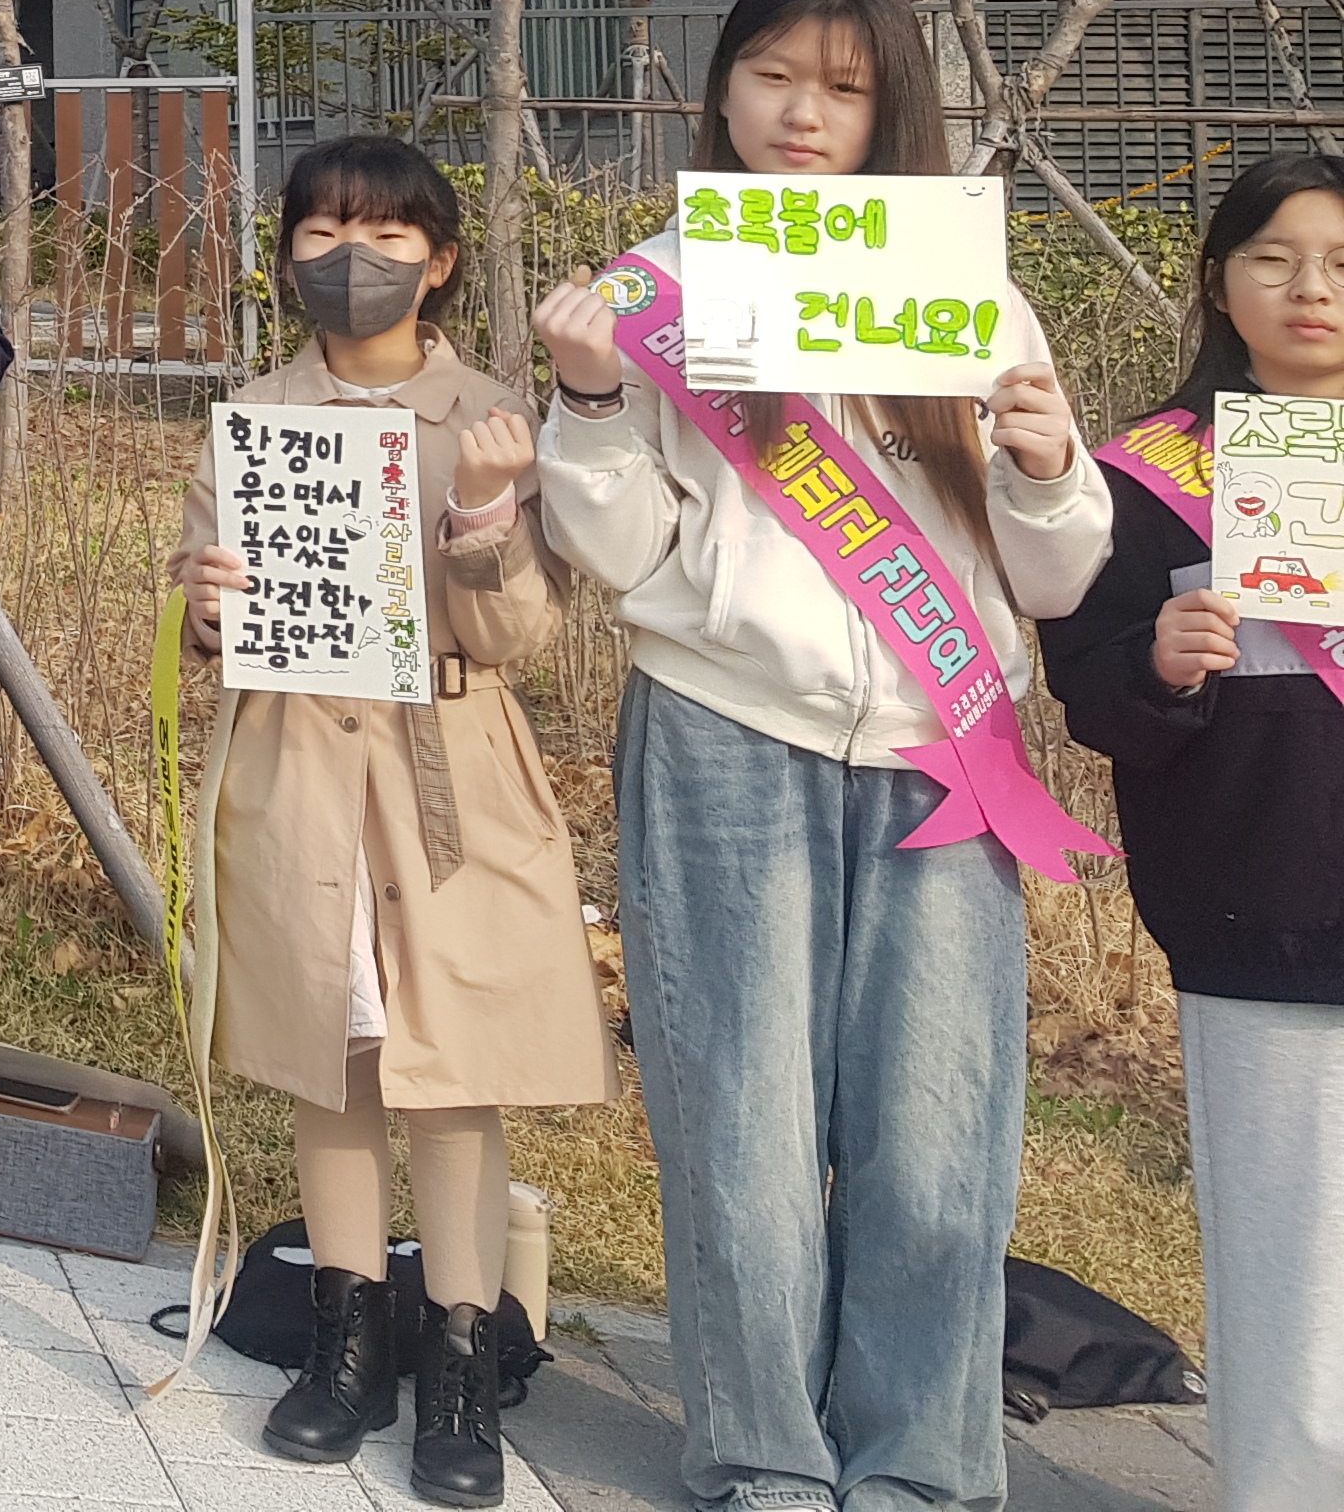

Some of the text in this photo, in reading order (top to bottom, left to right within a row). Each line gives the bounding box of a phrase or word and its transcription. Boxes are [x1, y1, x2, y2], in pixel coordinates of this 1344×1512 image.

[683, 187, 887, 255] 초록불에
[795, 291, 1000, 360] 건너요!
[1221, 394, 1344, 464] 초록
[233, 471, 362, 516] 웃으면서
[244, 575, 355, 620] 안전한
[859, 544, 979, 686] 건너요
